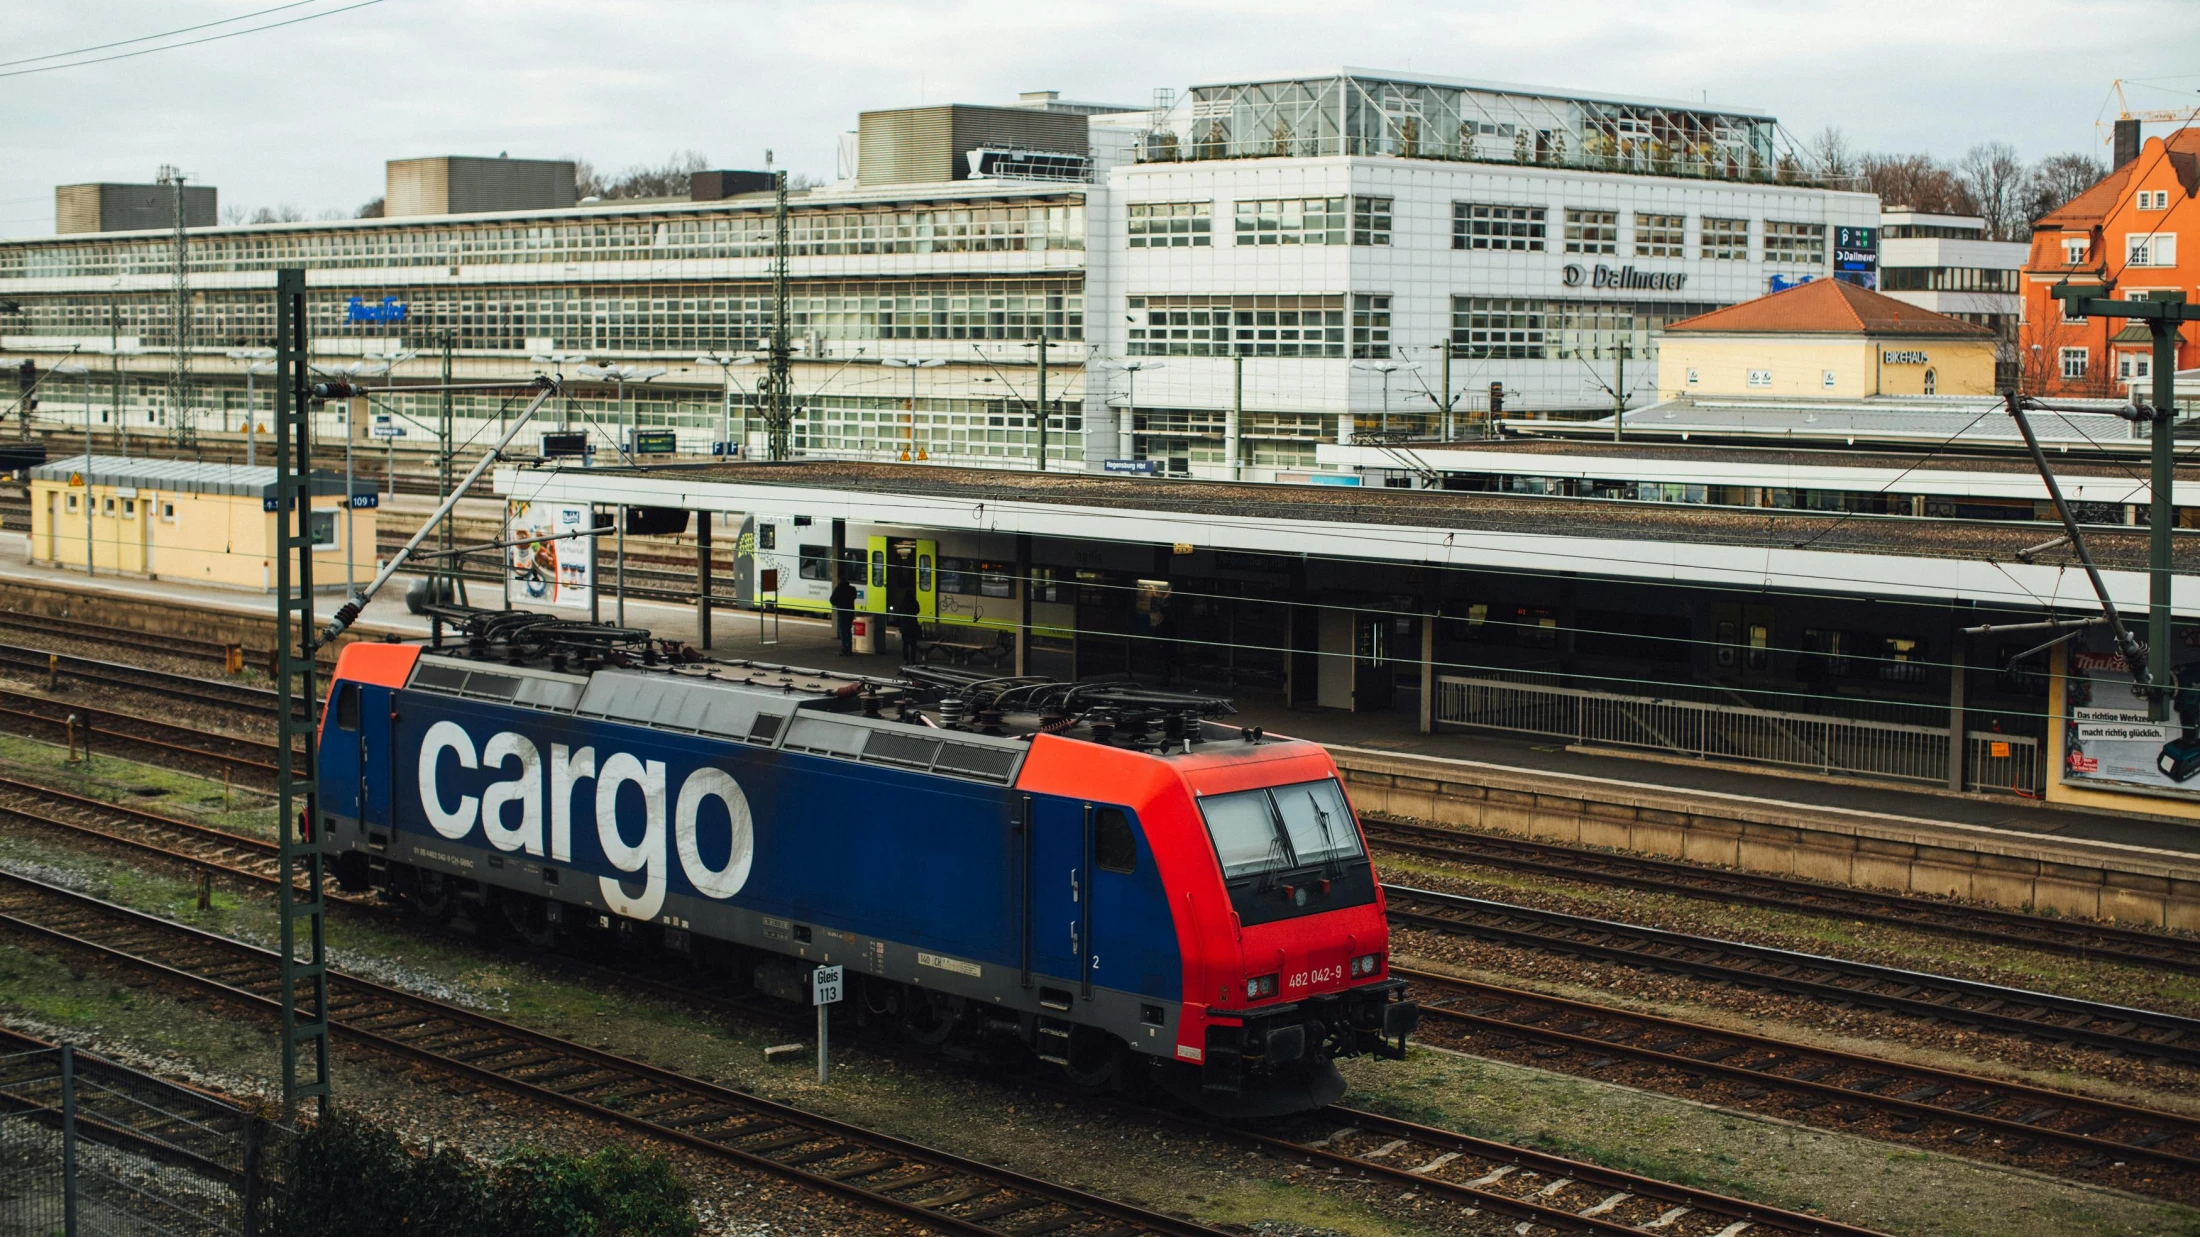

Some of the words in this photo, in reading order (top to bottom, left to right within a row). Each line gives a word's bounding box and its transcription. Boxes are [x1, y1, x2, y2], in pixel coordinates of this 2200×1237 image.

[1843, 250, 1876, 263] Dallmeier
[1593, 264, 1688, 291] Dallmeier
[1884, 350, 1930, 365] BIKEHAUS
[1106, 461, 1136, 470] Regensburg
[353, 497, 368, 507] 109
[2077, 711, 2090, 720] Das
[2092, 712, 2118, 722] richtige
[2082, 728, 2103, 737] macht
[2105, 729, 2127, 738] richtig
[2129, 729, 2163, 739] glücklich.
[418, 720, 755, 921] cargo
[920, 954, 931, 964] 140
[934, 957, 942, 967] CH
[1092, 955, 1099, 969] 2
[817, 969, 838, 984] Gleis
[1288, 972, 1308, 988] 482
[1311, 965, 1342, 984] 042-9
[819, 986, 837, 1002] 113
